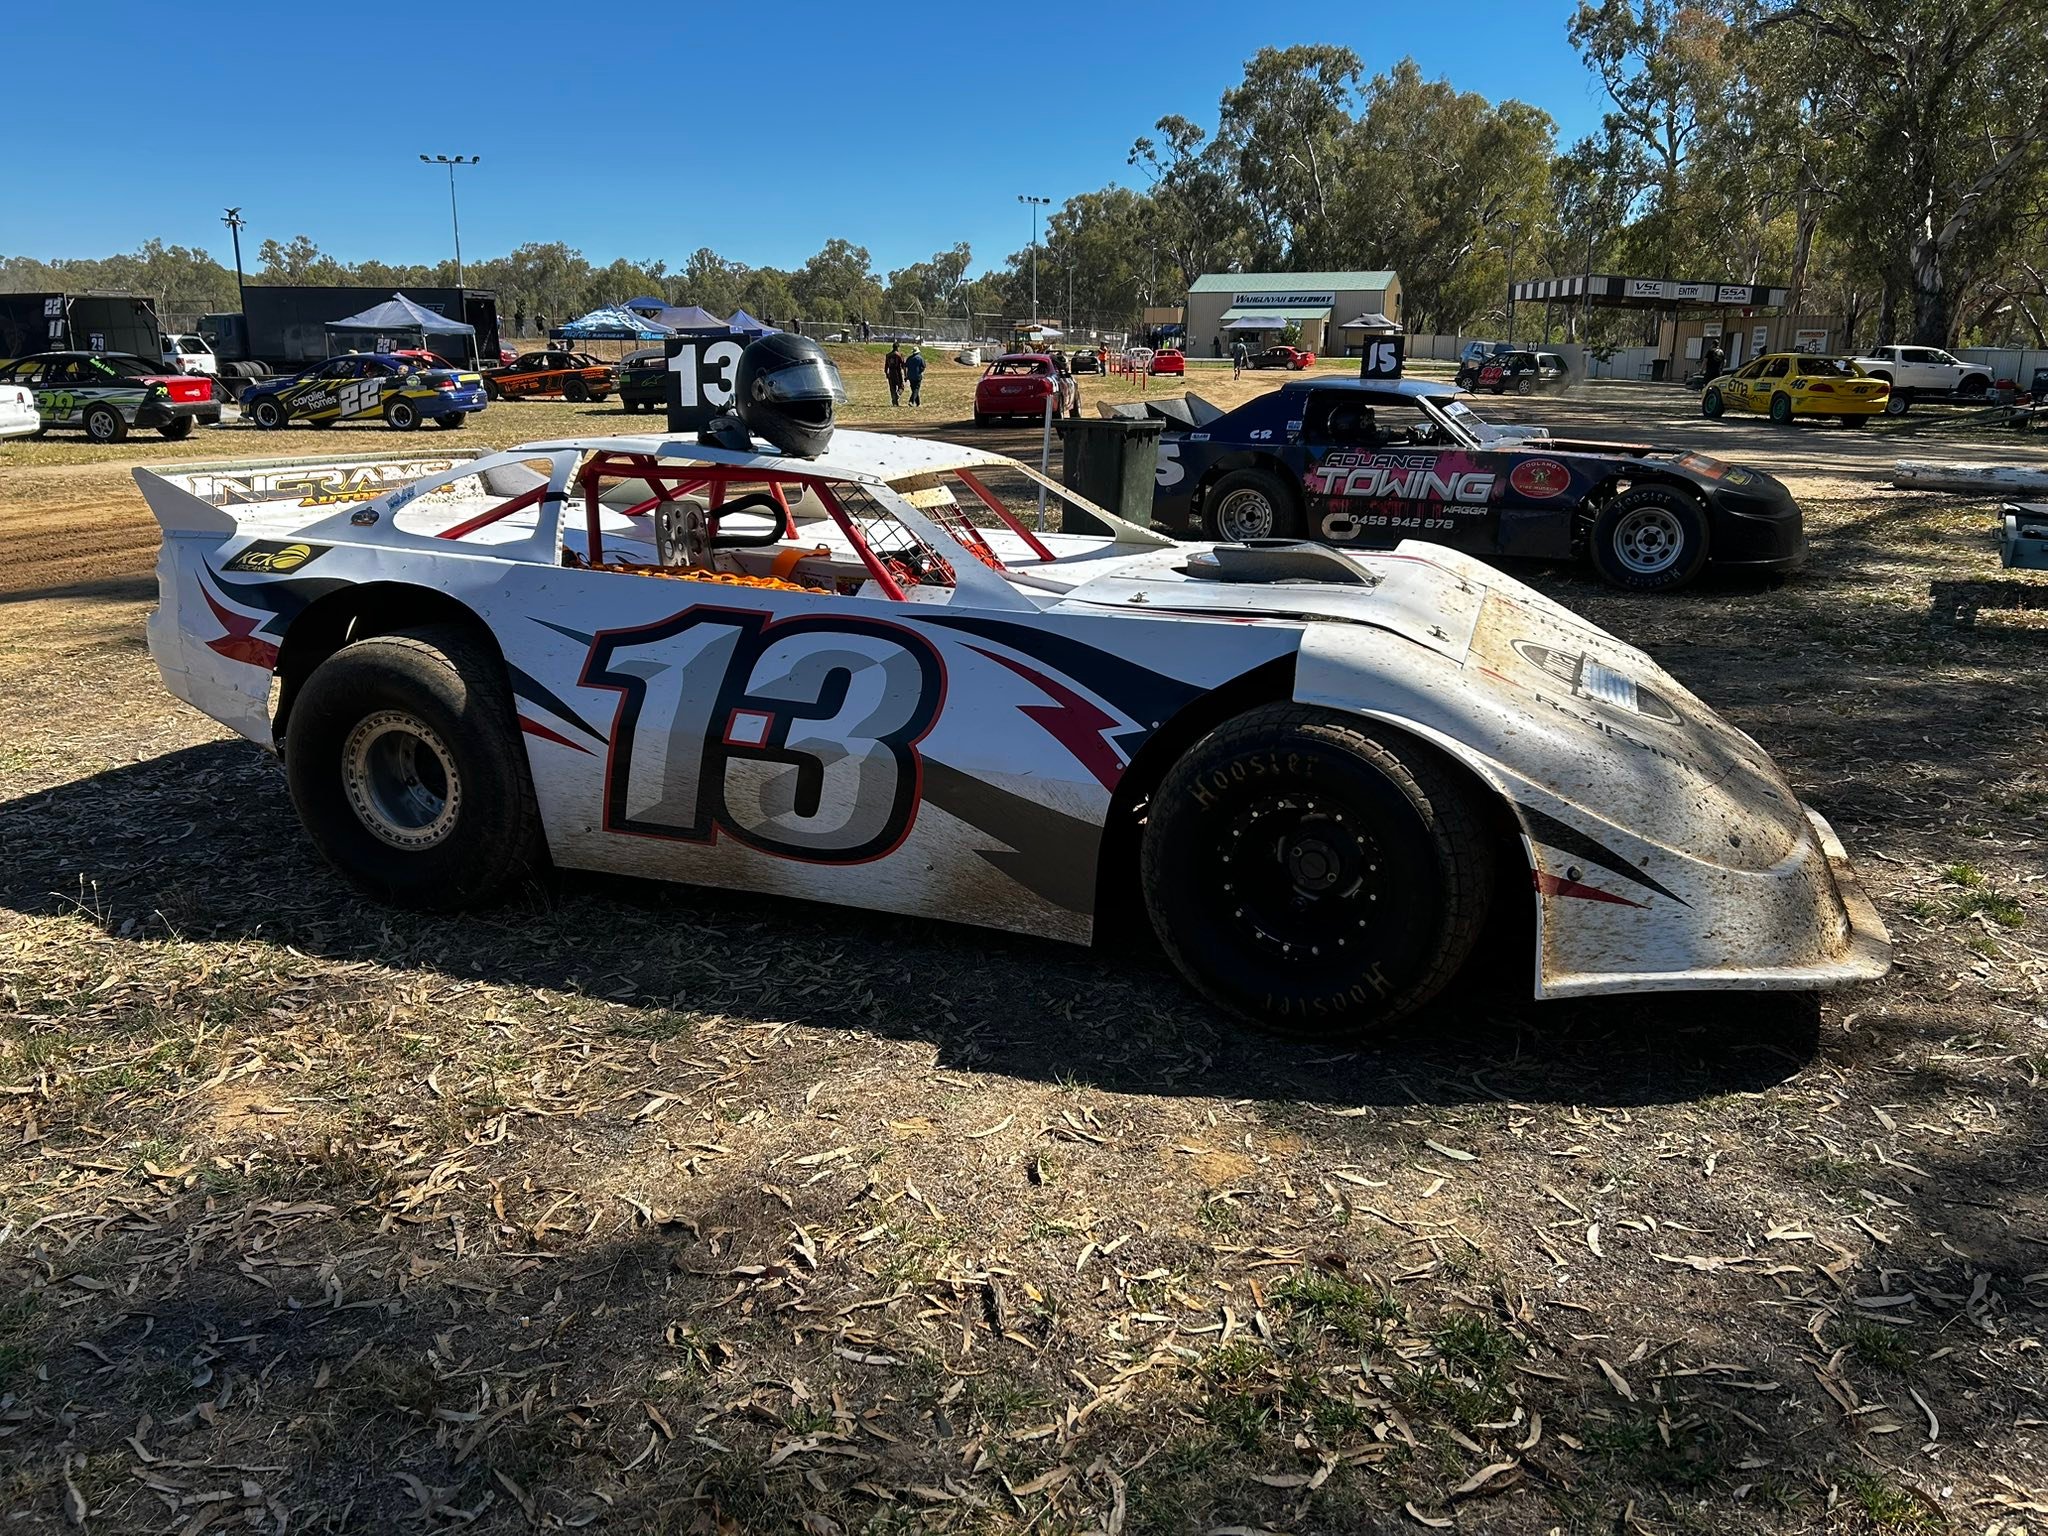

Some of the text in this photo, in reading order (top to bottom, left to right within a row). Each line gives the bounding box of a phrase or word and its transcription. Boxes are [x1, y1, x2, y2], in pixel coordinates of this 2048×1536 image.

[1635, 282, 1662, 291] VSC
[1678, 287, 1699, 295] ENTRY
[1720, 288, 1747, 296] SSA
[44, 297, 63, 316] 22
[48, 319, 66, 338] 11
[91, 337, 104, 351] 29
[376, 338, 390, 352] 22
[1368, 342, 1397, 373] 15
[668, 341, 744, 407] 13
[156, 386, 168, 396] 29
[1790, 379, 1808, 390] 46
[38, 391, 75, 420] 29
[292, 389, 326, 407] cavalier
[308, 395, 337, 411] homes
[339, 381, 380, 418] 22
[1249, 429, 1273, 439] CR
[1325, 452, 1438, 470] ADVANCE
[187, 460, 453, 507] INGRAMS
[1316, 467, 1496, 503] TOWING
[1443, 505, 1489, 516] WAGGA
[1349, 514, 1455, 530] 0458 942 878
[577, 603, 949, 867] 13
[1186, 751, 1320, 814] Hoosier
